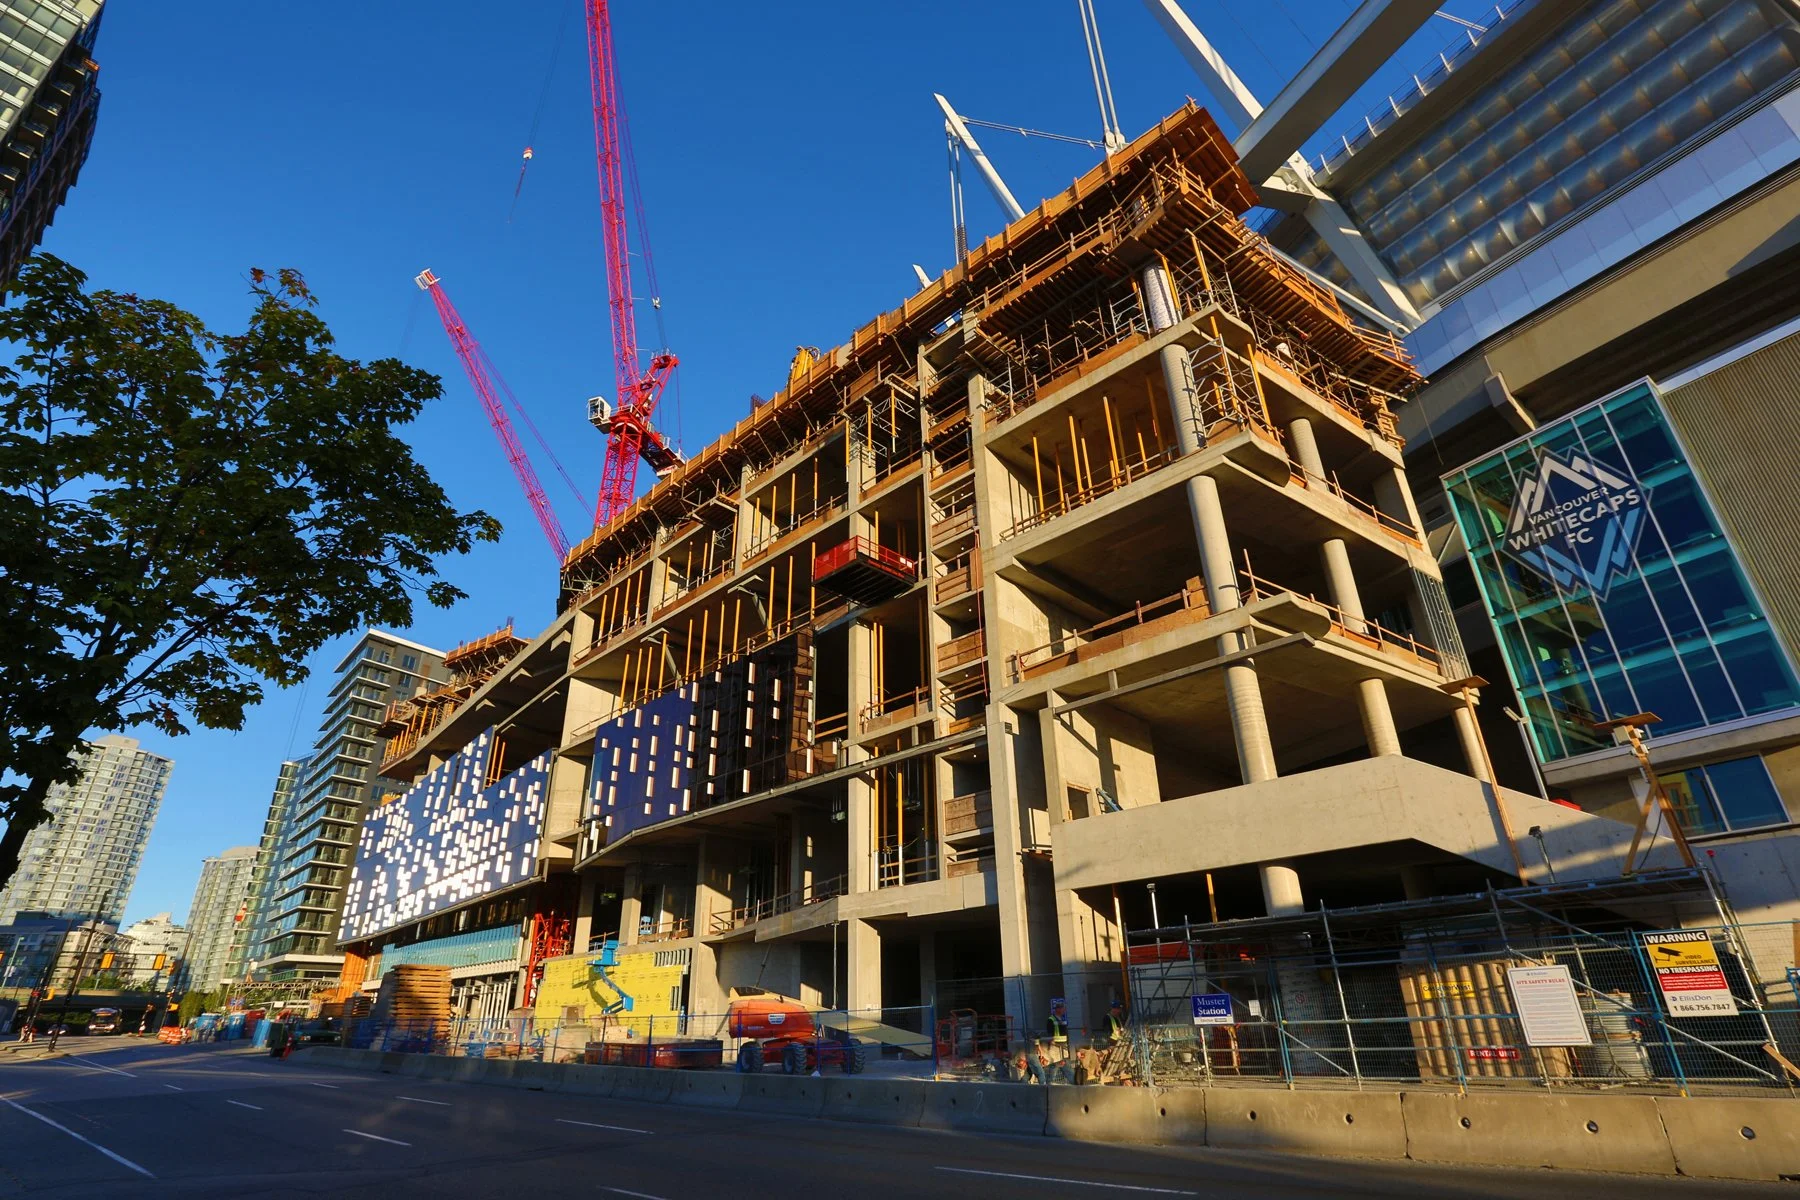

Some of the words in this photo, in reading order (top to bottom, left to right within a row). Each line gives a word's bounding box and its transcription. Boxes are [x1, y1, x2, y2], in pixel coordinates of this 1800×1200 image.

[1528, 487, 1608, 525] VANCOUVER
[1508, 488, 1641, 551] WHITECAPS
[1565, 528, 1594, 549] FC
[1646, 932, 1706, 943] WARNING
[1197, 998, 1225, 1006] Muster
[1198, 1007, 1227, 1015] Station
[1469, 1049, 1496, 1057] RENTAL
[1498, 1049, 1516, 1058] UNIT
